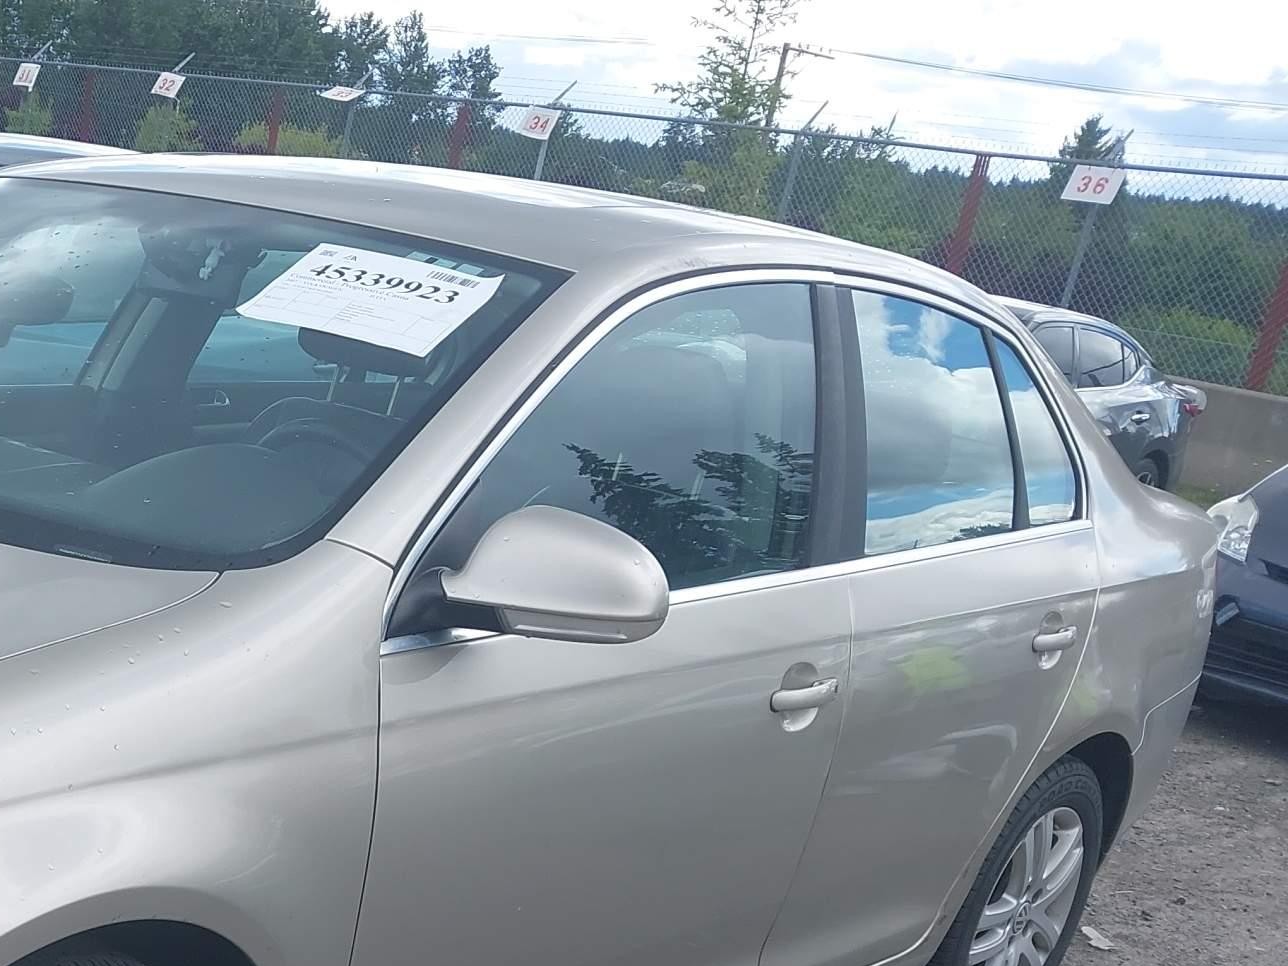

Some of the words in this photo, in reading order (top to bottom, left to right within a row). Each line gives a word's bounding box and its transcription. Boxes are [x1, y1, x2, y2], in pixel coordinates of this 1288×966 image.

[158, 78, 177, 92] 32
[529, 115, 551, 132] 34
[1076, 175, 1109, 194] 36
[309, 263, 460, 304] 45339923
